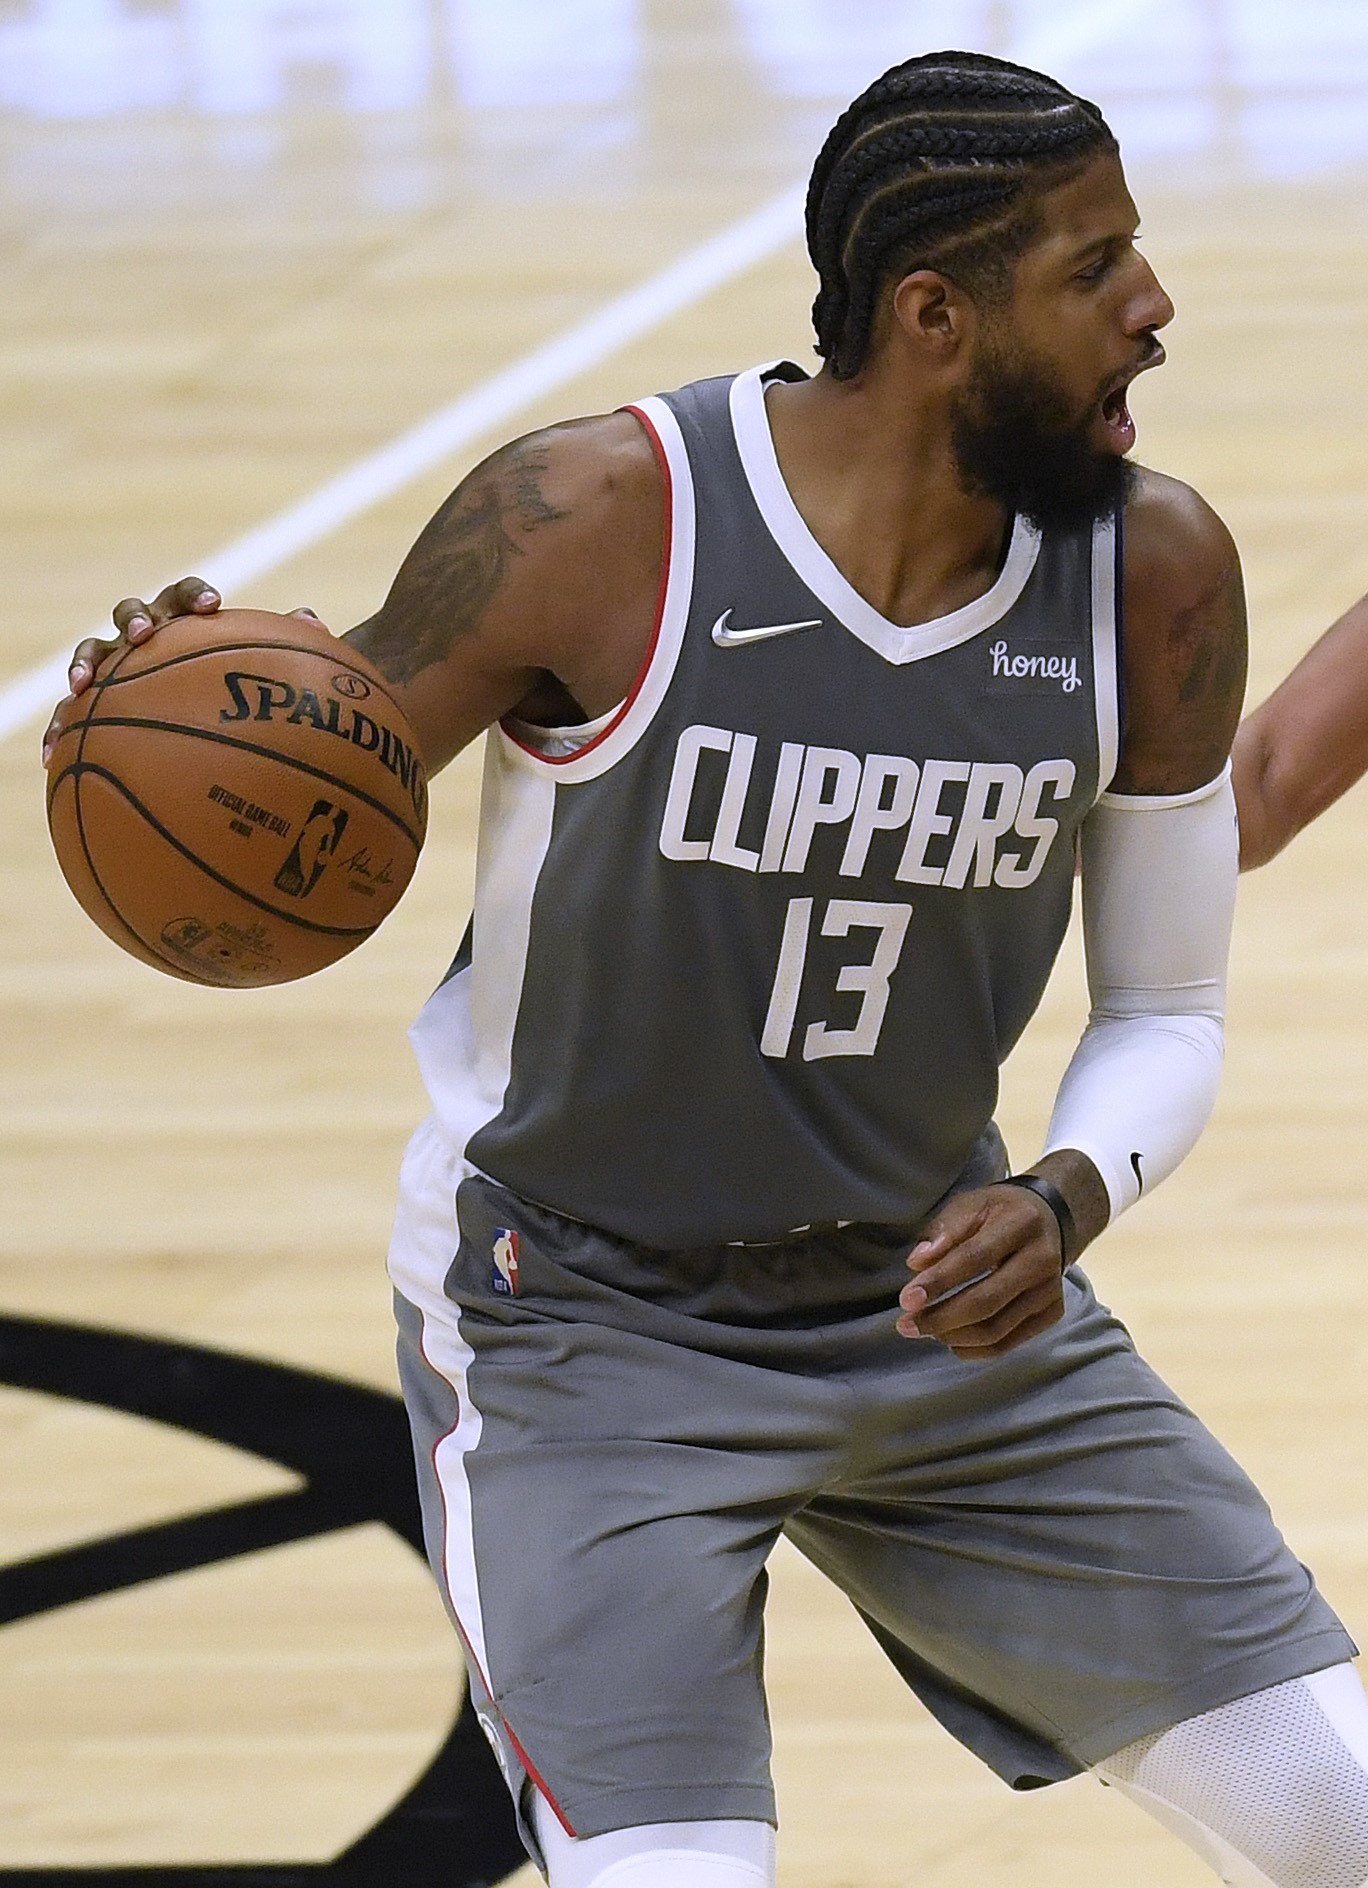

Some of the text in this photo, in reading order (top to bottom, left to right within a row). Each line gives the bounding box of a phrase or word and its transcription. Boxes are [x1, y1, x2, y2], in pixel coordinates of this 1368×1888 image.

[989, 640, 1082, 692] honey
[207, 784, 247, 815] OFFICIAL
[244, 803, 272, 827] GAME
[268, 816, 291, 838] BALL
[659, 724, 1076, 889] CLIPPERS
[760, 897, 913, 1062] 13
